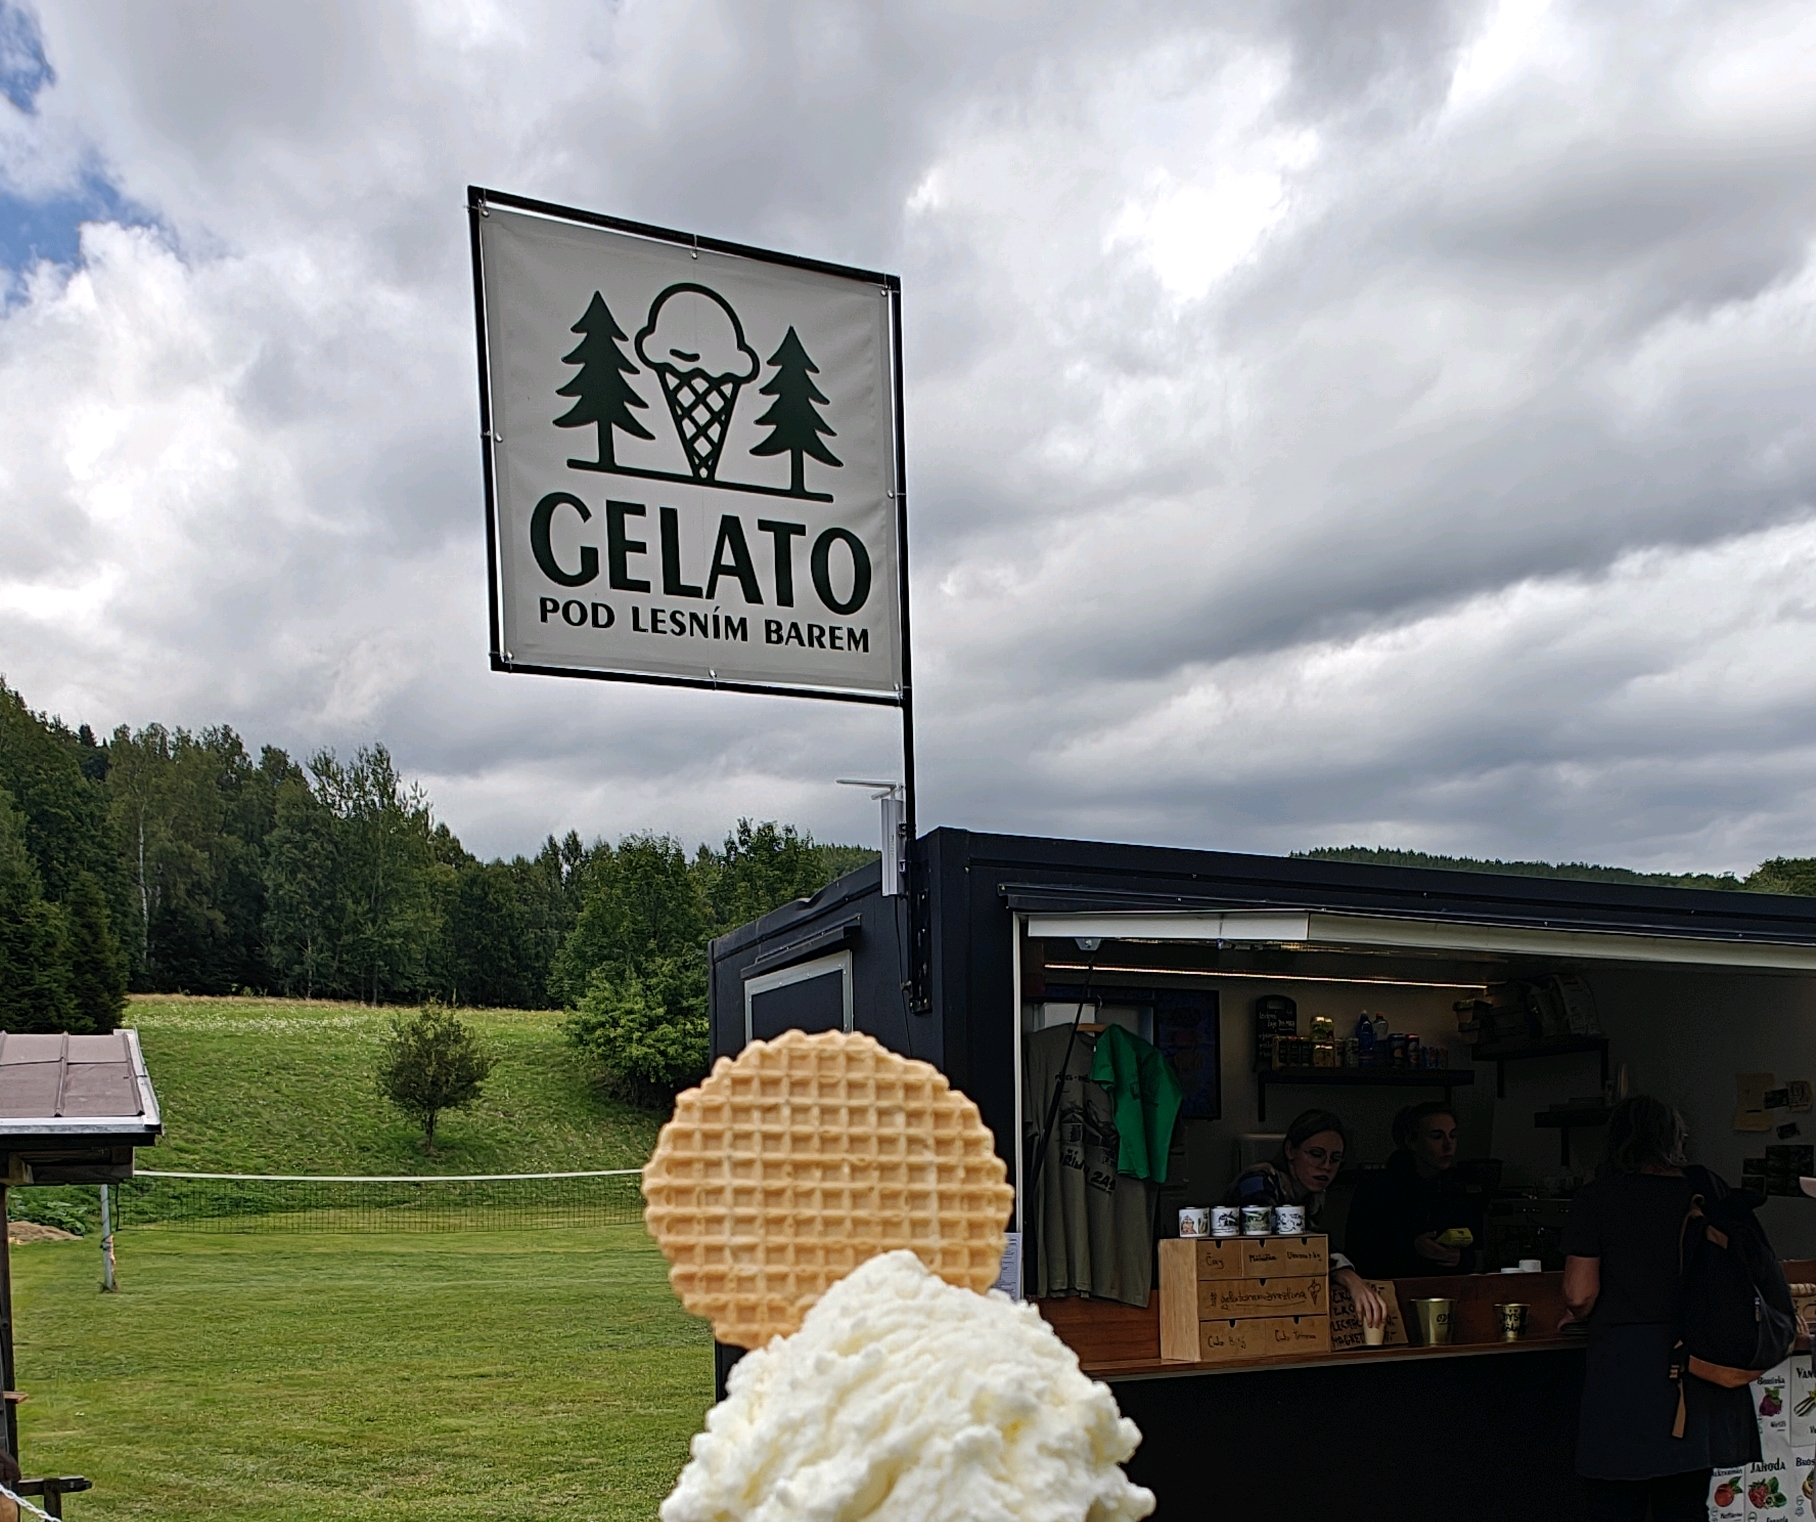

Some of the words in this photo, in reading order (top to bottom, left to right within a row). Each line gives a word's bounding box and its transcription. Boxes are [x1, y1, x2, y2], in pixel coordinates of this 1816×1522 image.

[530, 491, 872, 615] GELATO
[538, 597, 616, 629] POD
[631, 605, 749, 643] LESNÍM
[763, 618, 871, 653] BAREM
